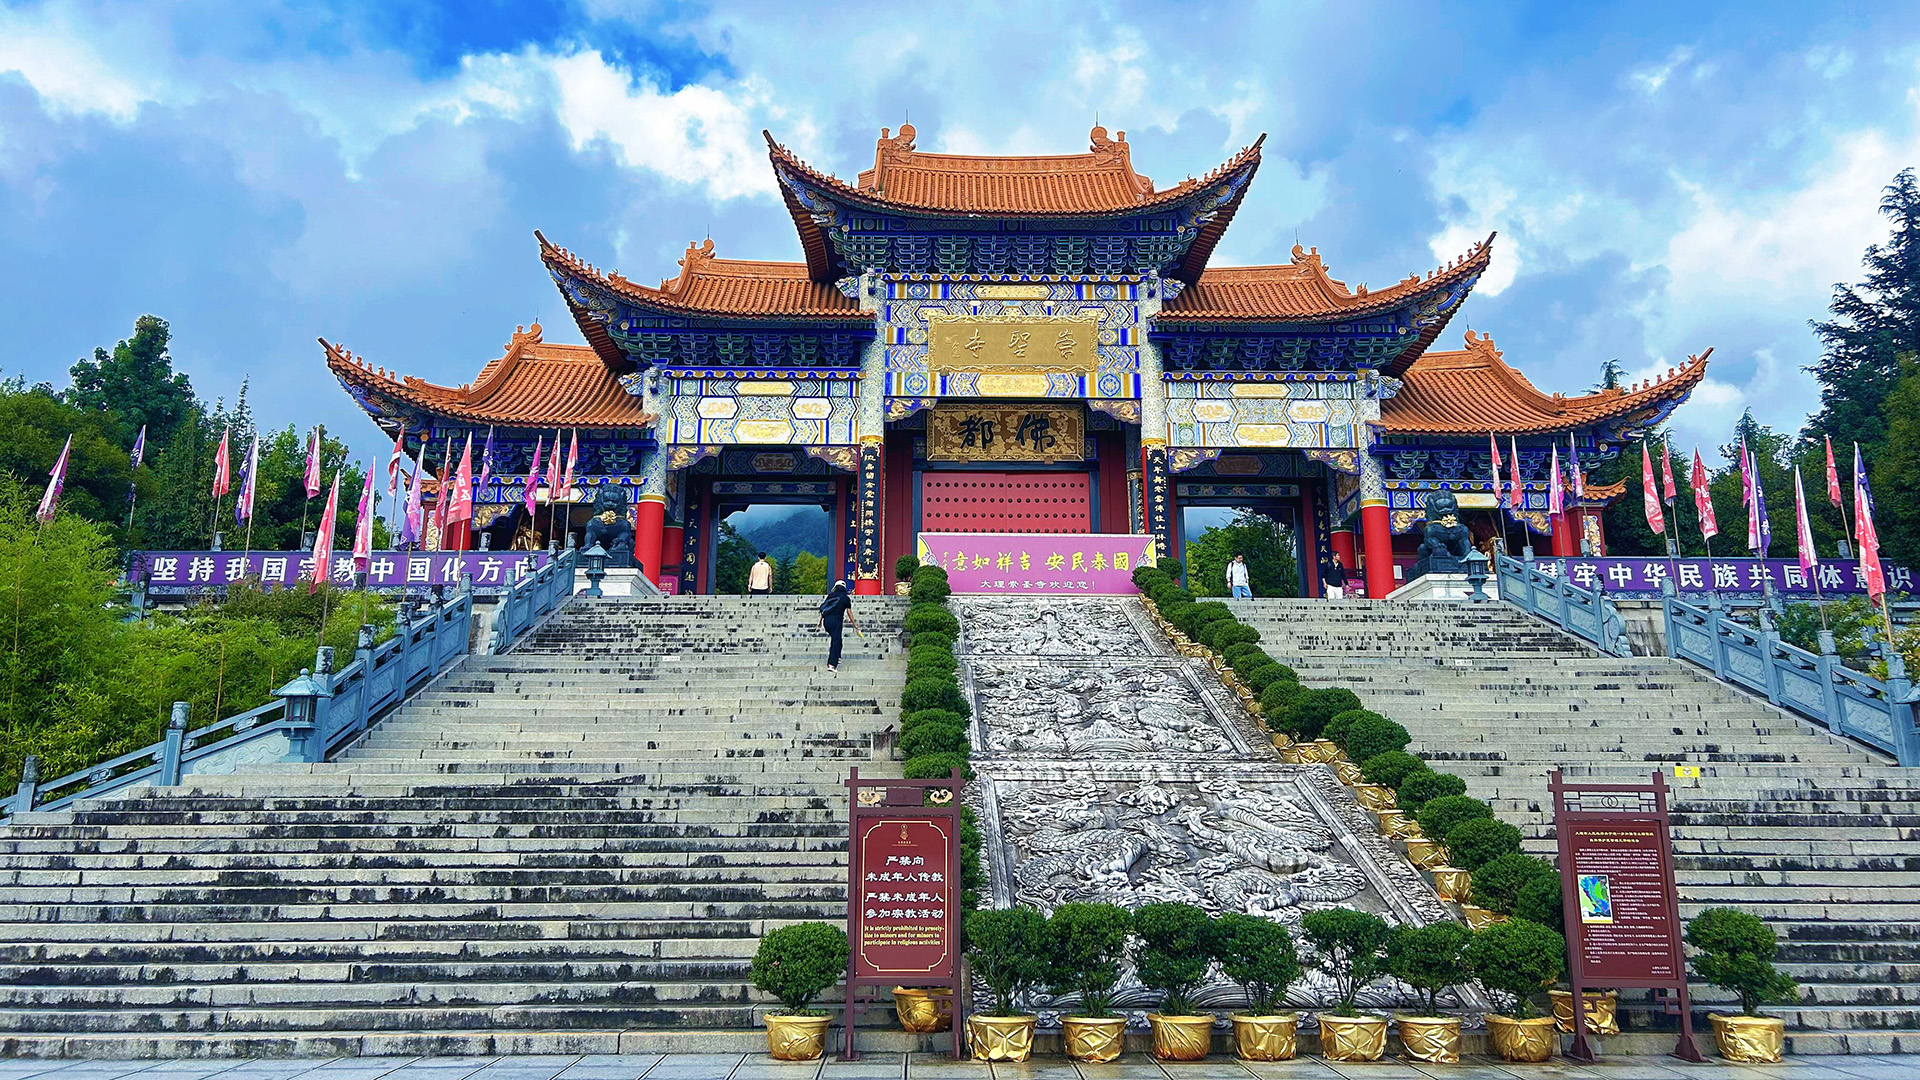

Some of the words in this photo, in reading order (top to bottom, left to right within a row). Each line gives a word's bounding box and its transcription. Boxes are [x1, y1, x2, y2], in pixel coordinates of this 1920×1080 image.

[957, 413, 1057, 453] 佛都
[885, 855, 925, 866] 严禁向
[865, 871, 944, 882] 未成年人传教
[864, 892, 944, 902] 严禁未成年人
[865, 908, 944, 919] 参加宗教活动
